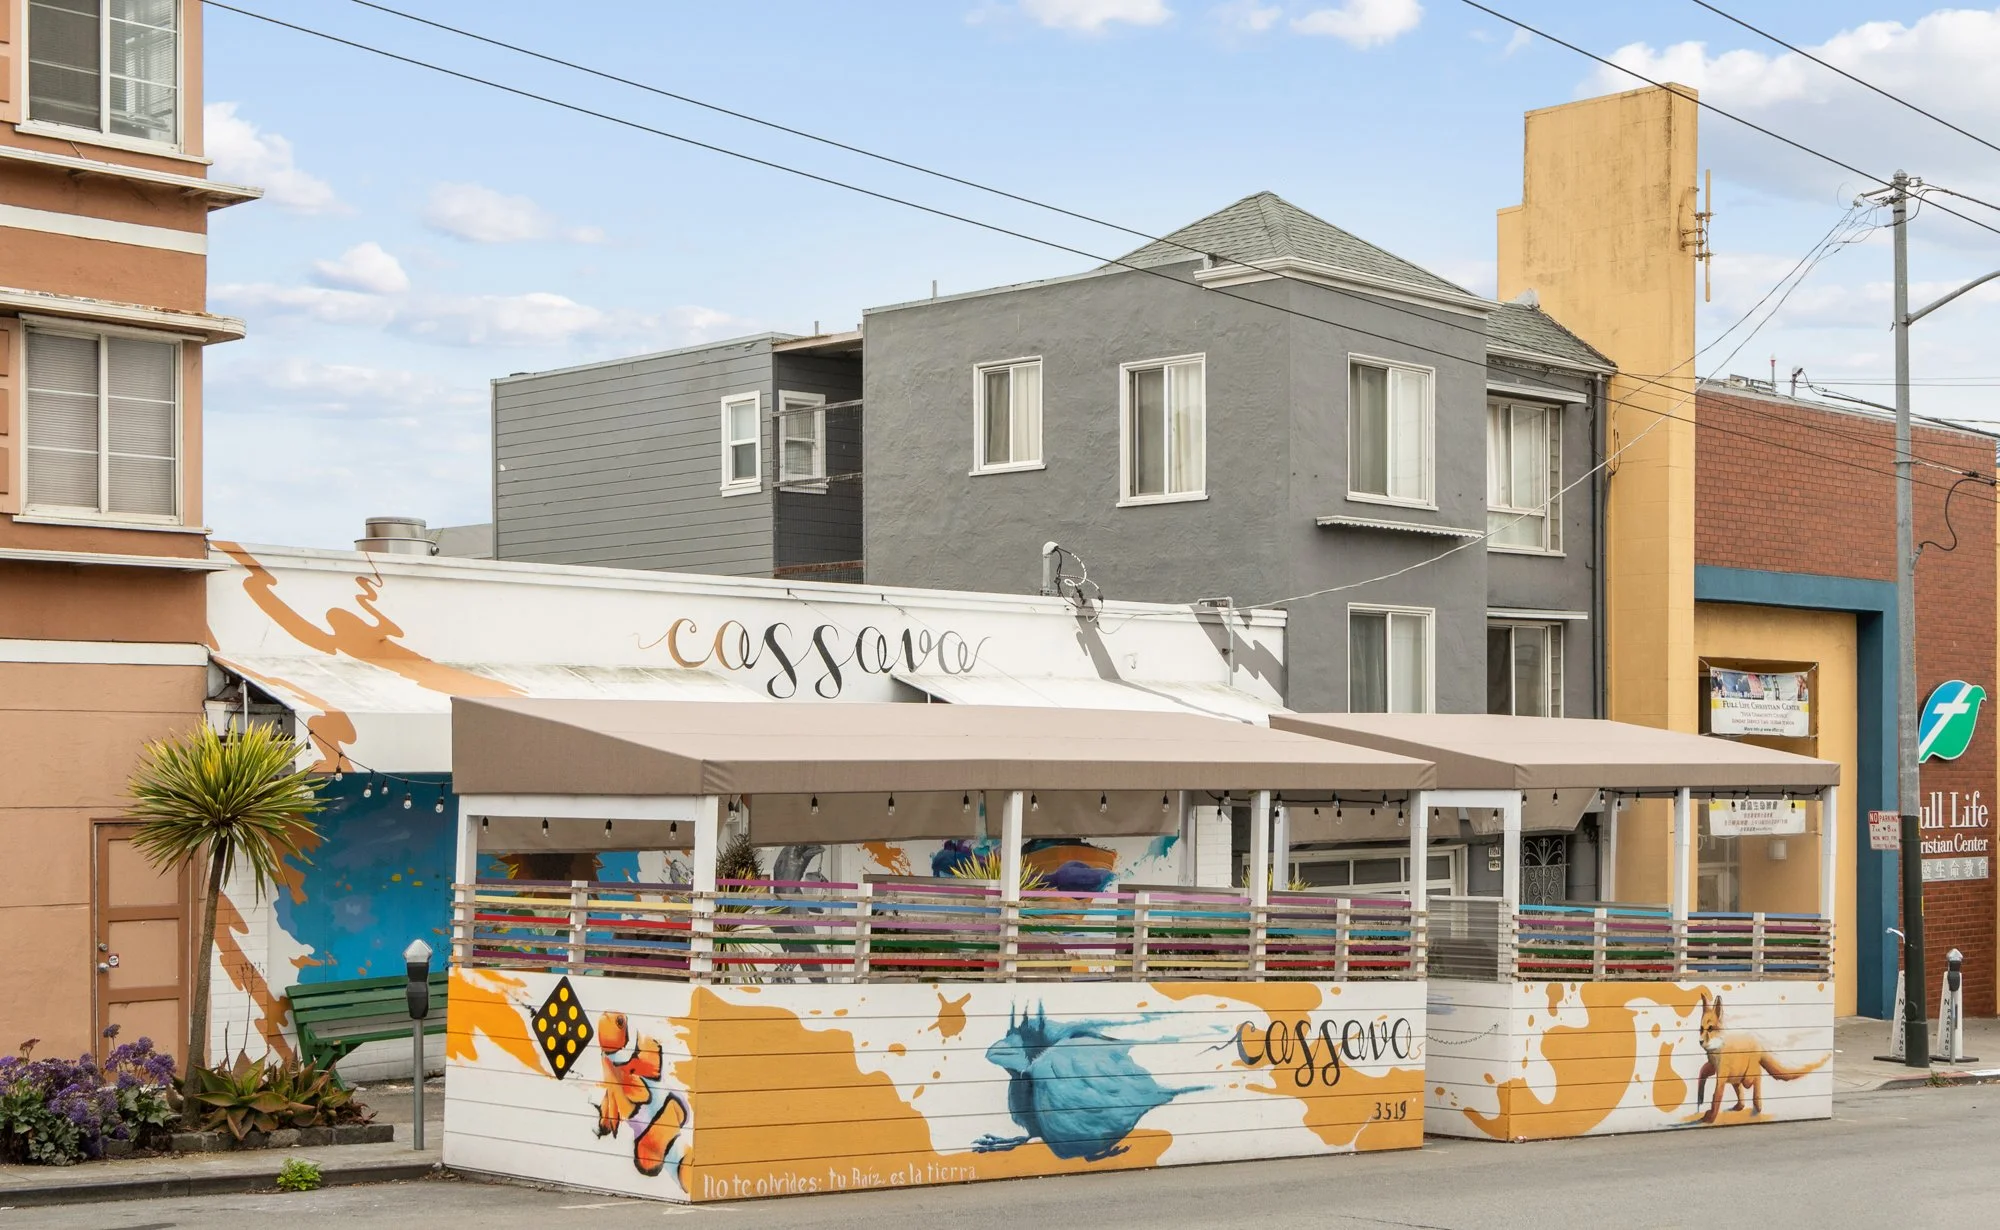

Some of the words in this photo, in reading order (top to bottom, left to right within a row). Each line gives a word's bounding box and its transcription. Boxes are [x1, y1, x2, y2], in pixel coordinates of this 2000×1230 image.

[633, 617, 992, 699] cassava
[1870, 812, 1879, 823] NO
[1920, 790, 1945, 829] ull
[1949, 790, 1989, 828] Life
[1920, 834, 1953, 854] ristian
[1954, 833, 1989, 852] Center
[1921, 859, 1988, 879] 盛生命教會
[1196, 1018, 1424, 1087] cassava
[1372, 1100, 1408, 1120] 3519
[732, 1174, 752, 1197] te
[756, 1172, 822, 1196] olvides:
[828, 1166, 847, 1190] tu
[890, 1171, 906, 1185] es
[908, 1162, 922, 1184] la
